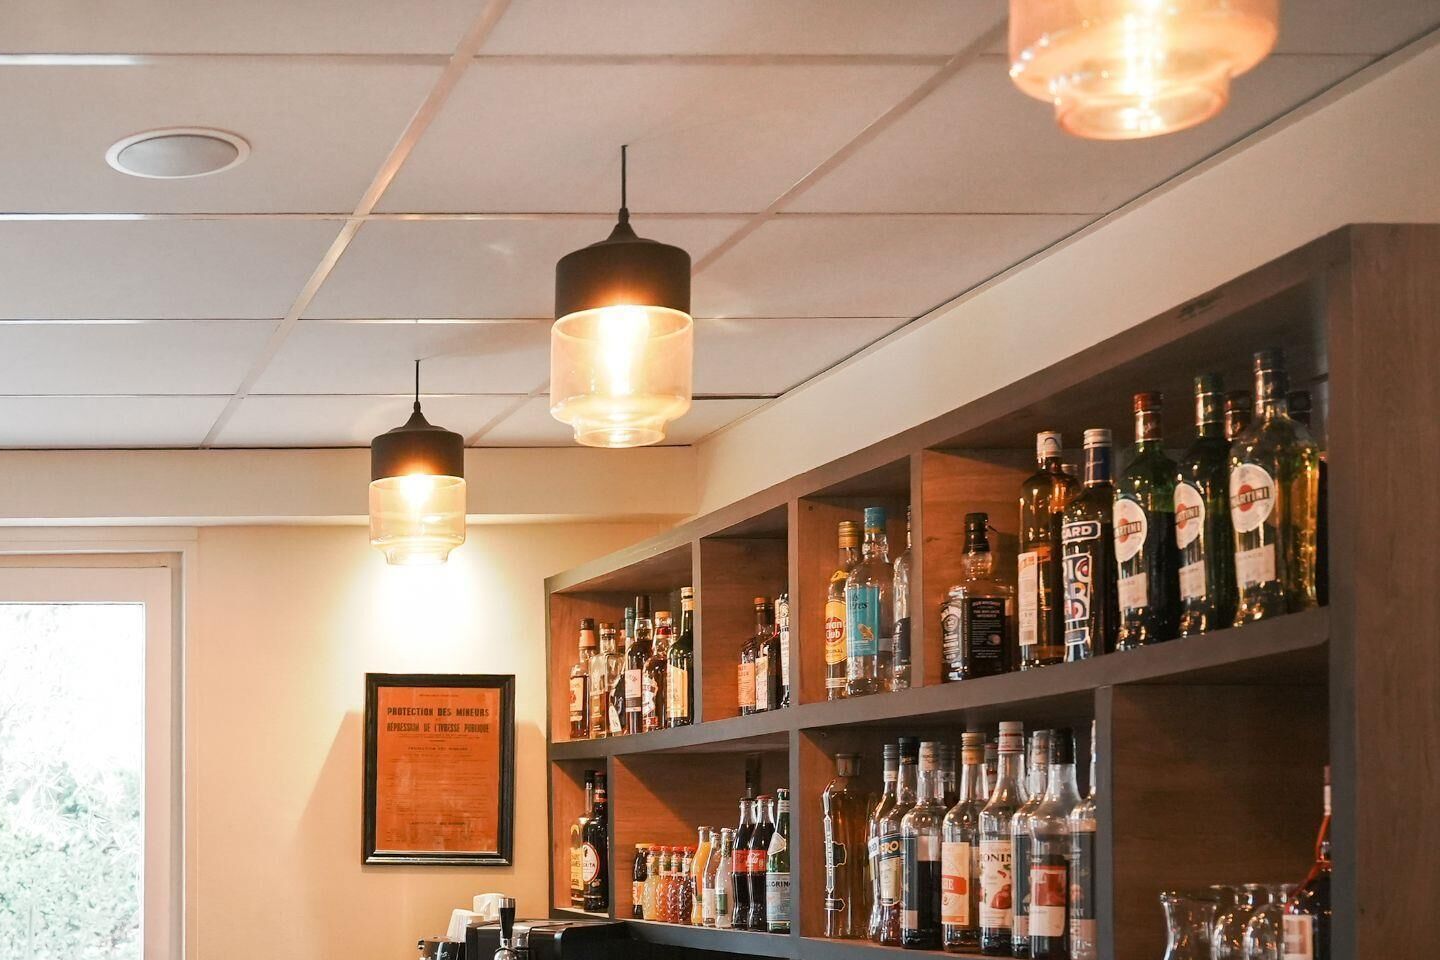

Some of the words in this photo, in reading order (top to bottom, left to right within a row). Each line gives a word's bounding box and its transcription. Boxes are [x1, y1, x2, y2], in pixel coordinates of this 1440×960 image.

[387, 708, 433, 716] PROTECTION
[437, 708, 452, 717] DES
[456, 708, 489, 717] MINEURS
